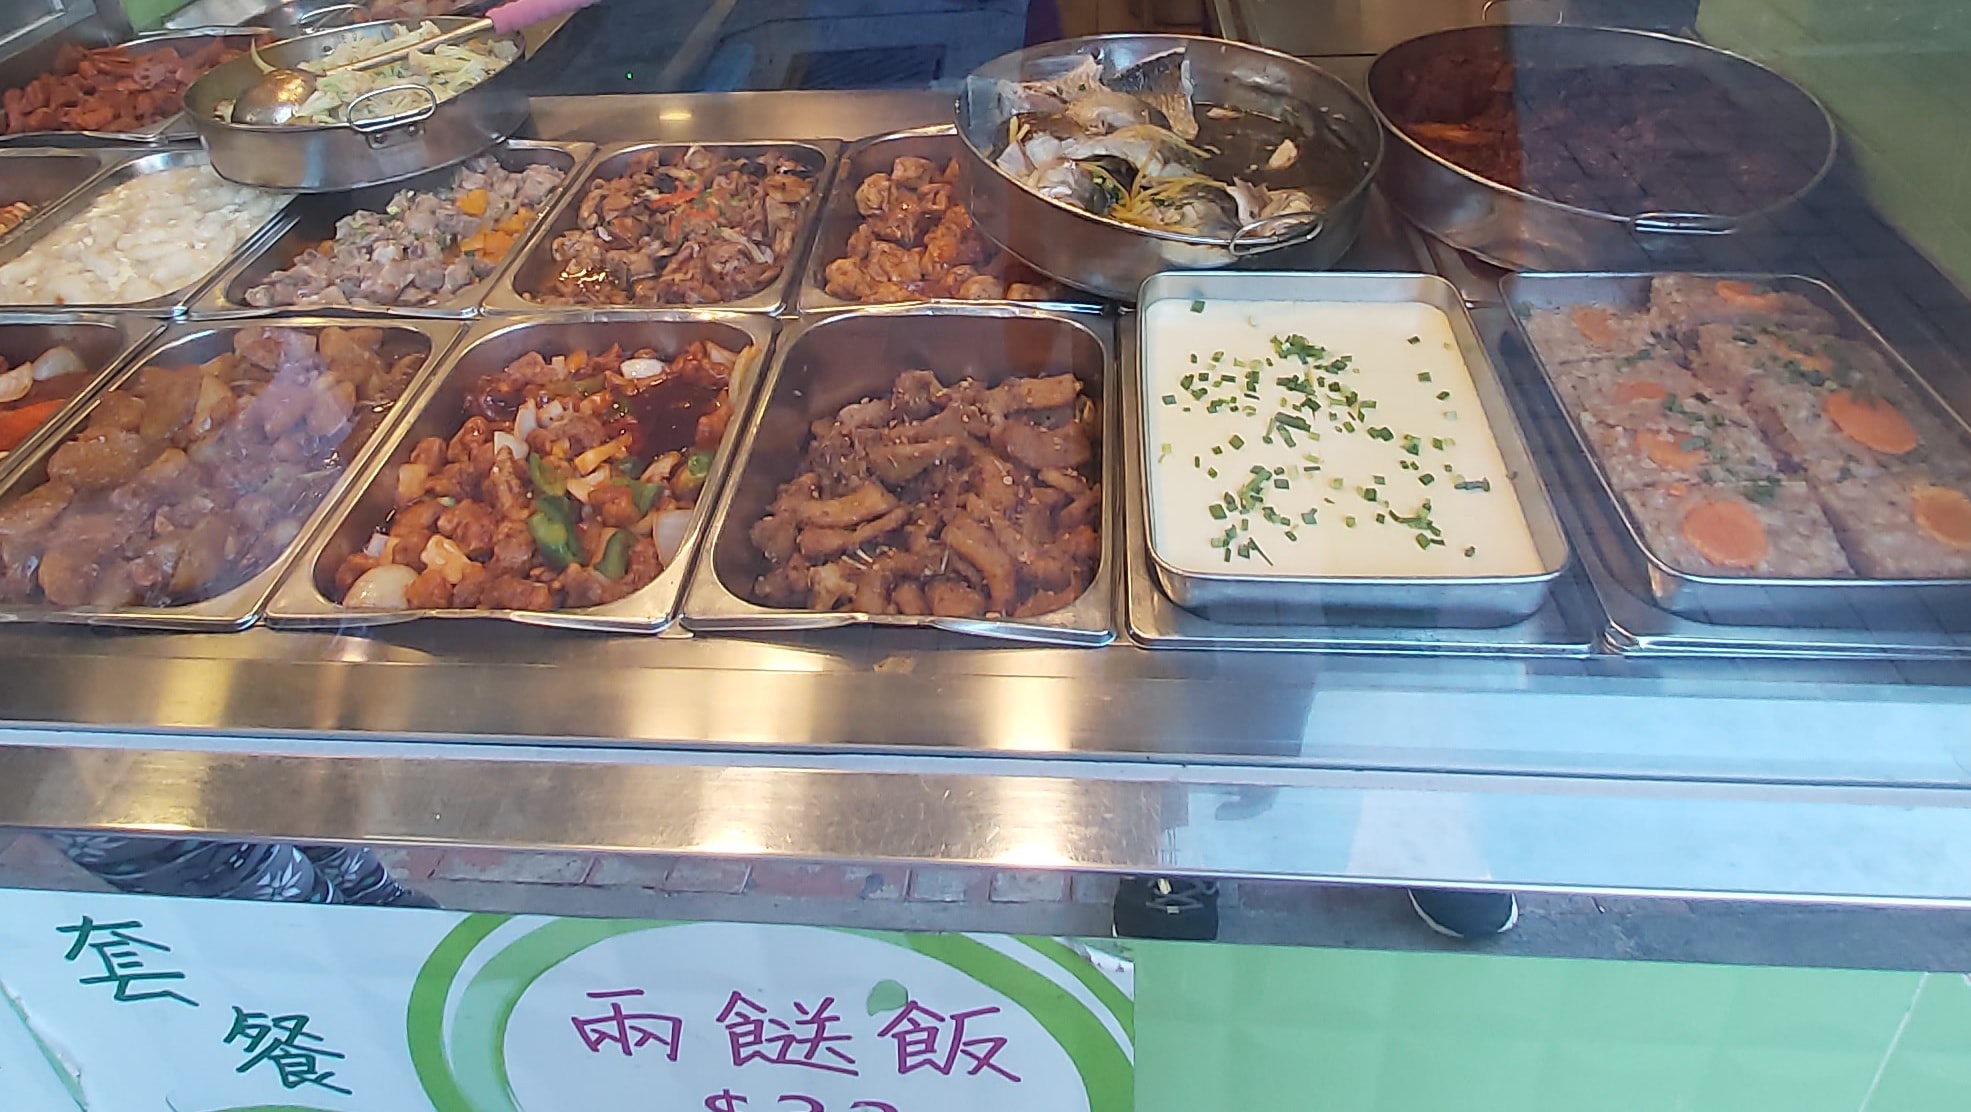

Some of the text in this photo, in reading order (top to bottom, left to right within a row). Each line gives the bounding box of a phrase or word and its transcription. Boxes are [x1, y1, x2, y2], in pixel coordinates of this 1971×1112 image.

[56, 915, 353, 1096] 套餐
[570, 989, 1022, 1083] 兩餸飯
